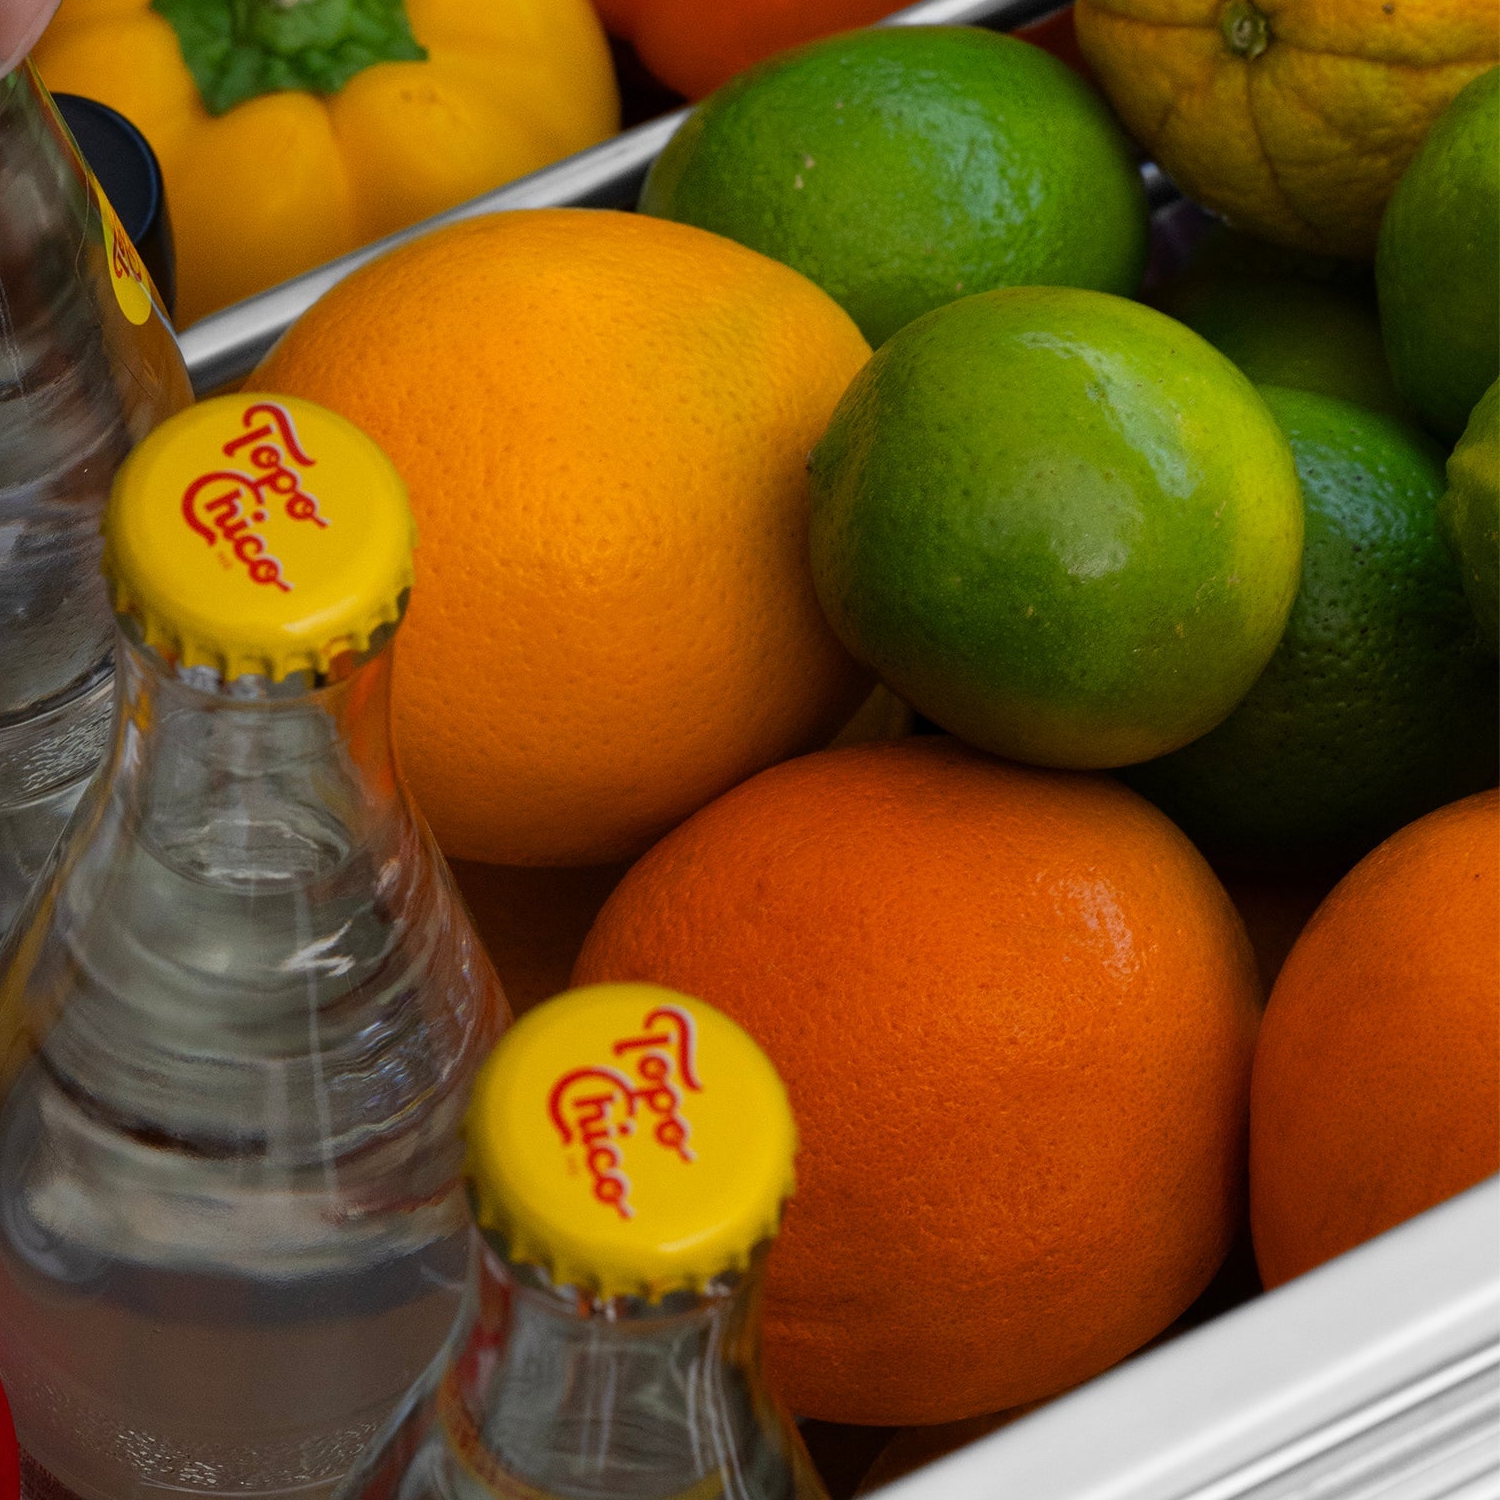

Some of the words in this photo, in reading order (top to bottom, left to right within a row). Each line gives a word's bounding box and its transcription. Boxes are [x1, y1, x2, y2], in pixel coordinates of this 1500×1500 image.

[181, 468, 295, 593] Chico
[222, 402, 332, 529] Topo
[547, 1064, 637, 1220] Chico
[613, 1003, 705, 1163] Topo
